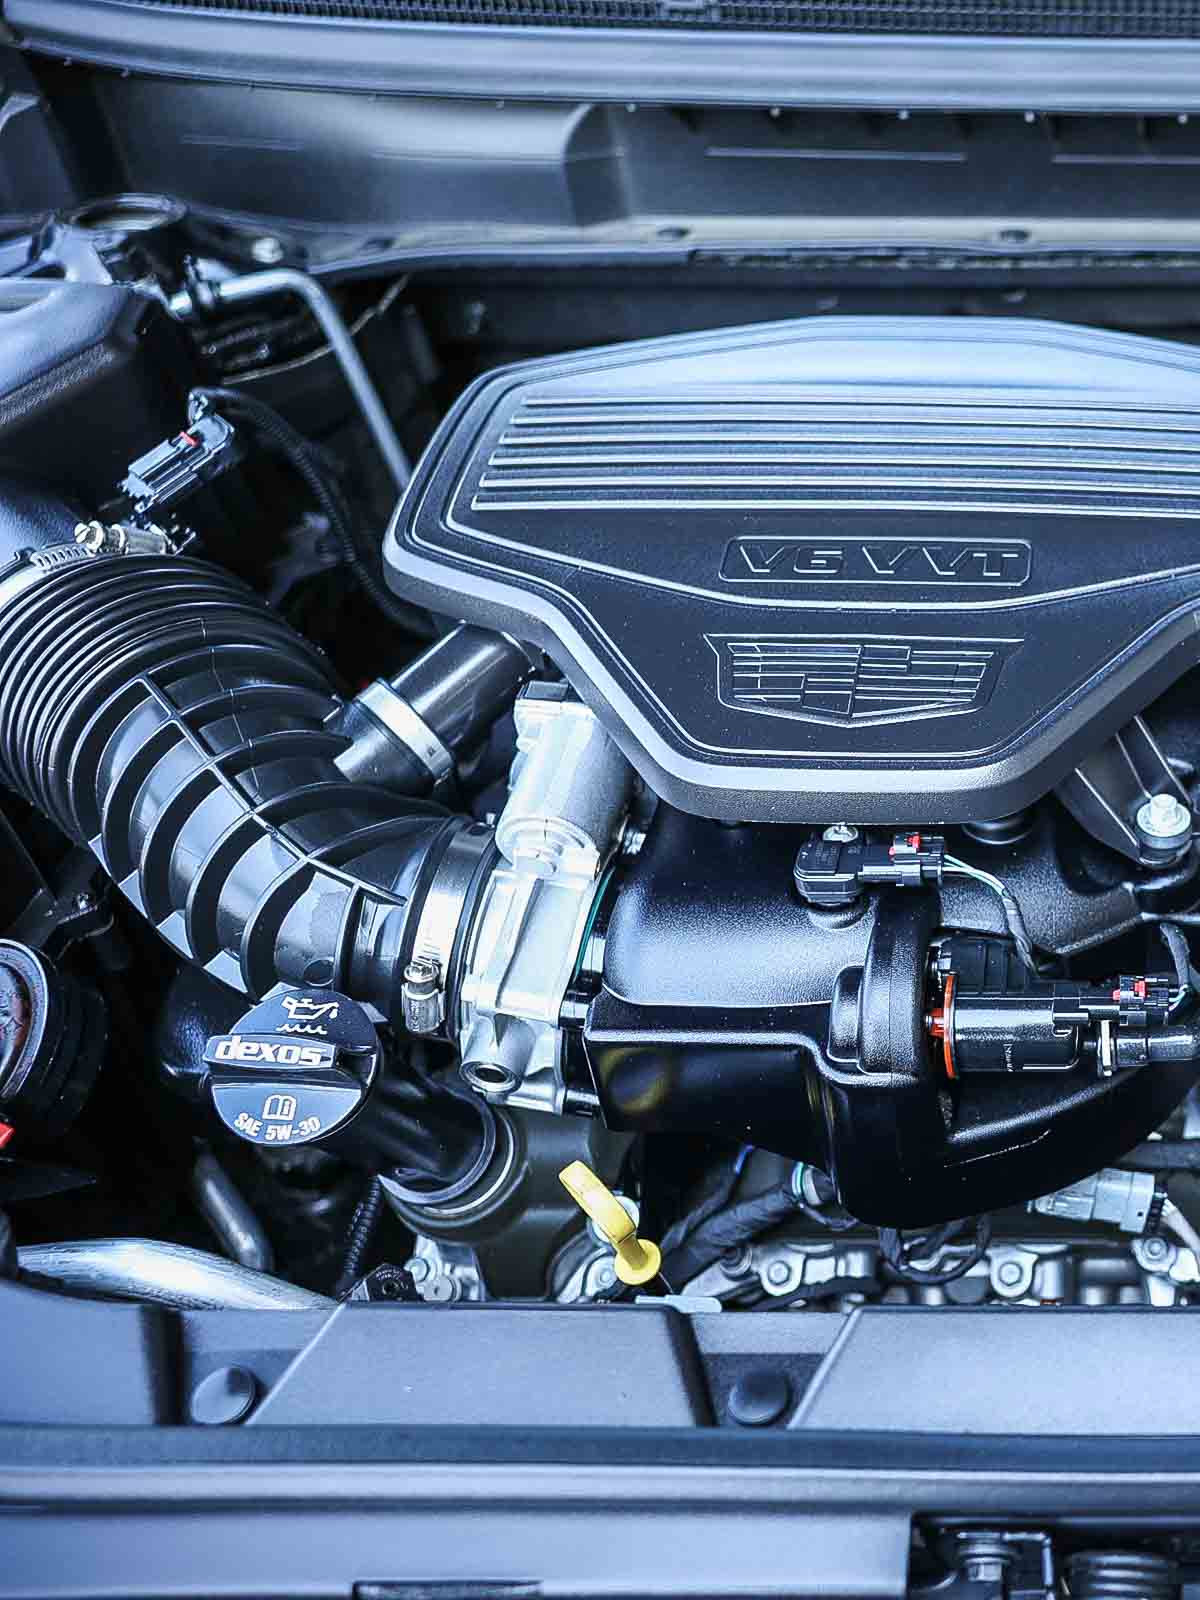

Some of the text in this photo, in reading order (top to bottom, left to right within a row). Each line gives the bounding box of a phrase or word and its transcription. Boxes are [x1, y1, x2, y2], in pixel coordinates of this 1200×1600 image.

[738, 544, 1021, 578] V6 VVT
[215, 1035, 327, 1065] dexos
[234, 1112, 321, 1140] SAE 5W-30
